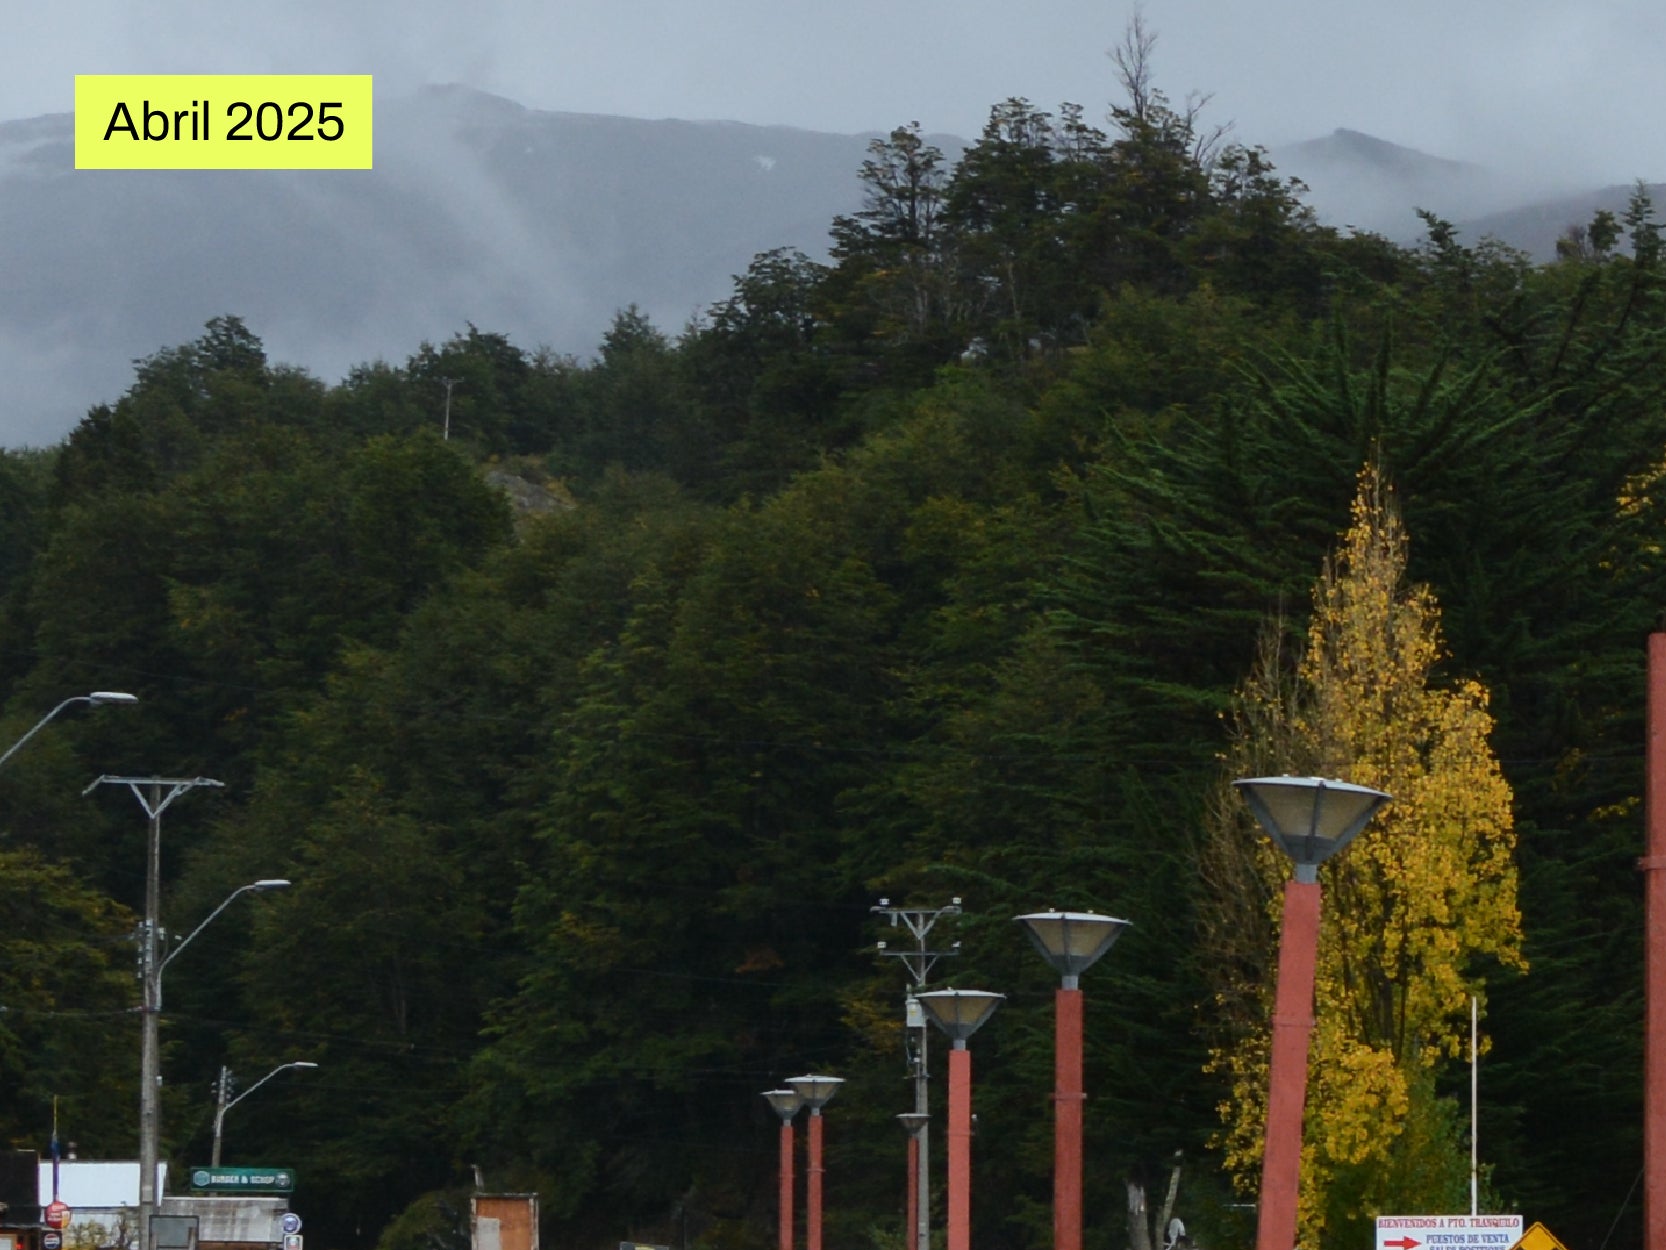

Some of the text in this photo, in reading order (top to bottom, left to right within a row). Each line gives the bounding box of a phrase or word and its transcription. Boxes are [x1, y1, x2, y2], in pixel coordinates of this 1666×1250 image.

[1378, 1218, 1436, 1228] BIENVENIDOS
[1439, 1218, 1445, 1228] A
[1469, 1218, 1520, 1228] TRANQUILO
[1426, 1233, 1509, 1244] PUESTOS DE VENTA
